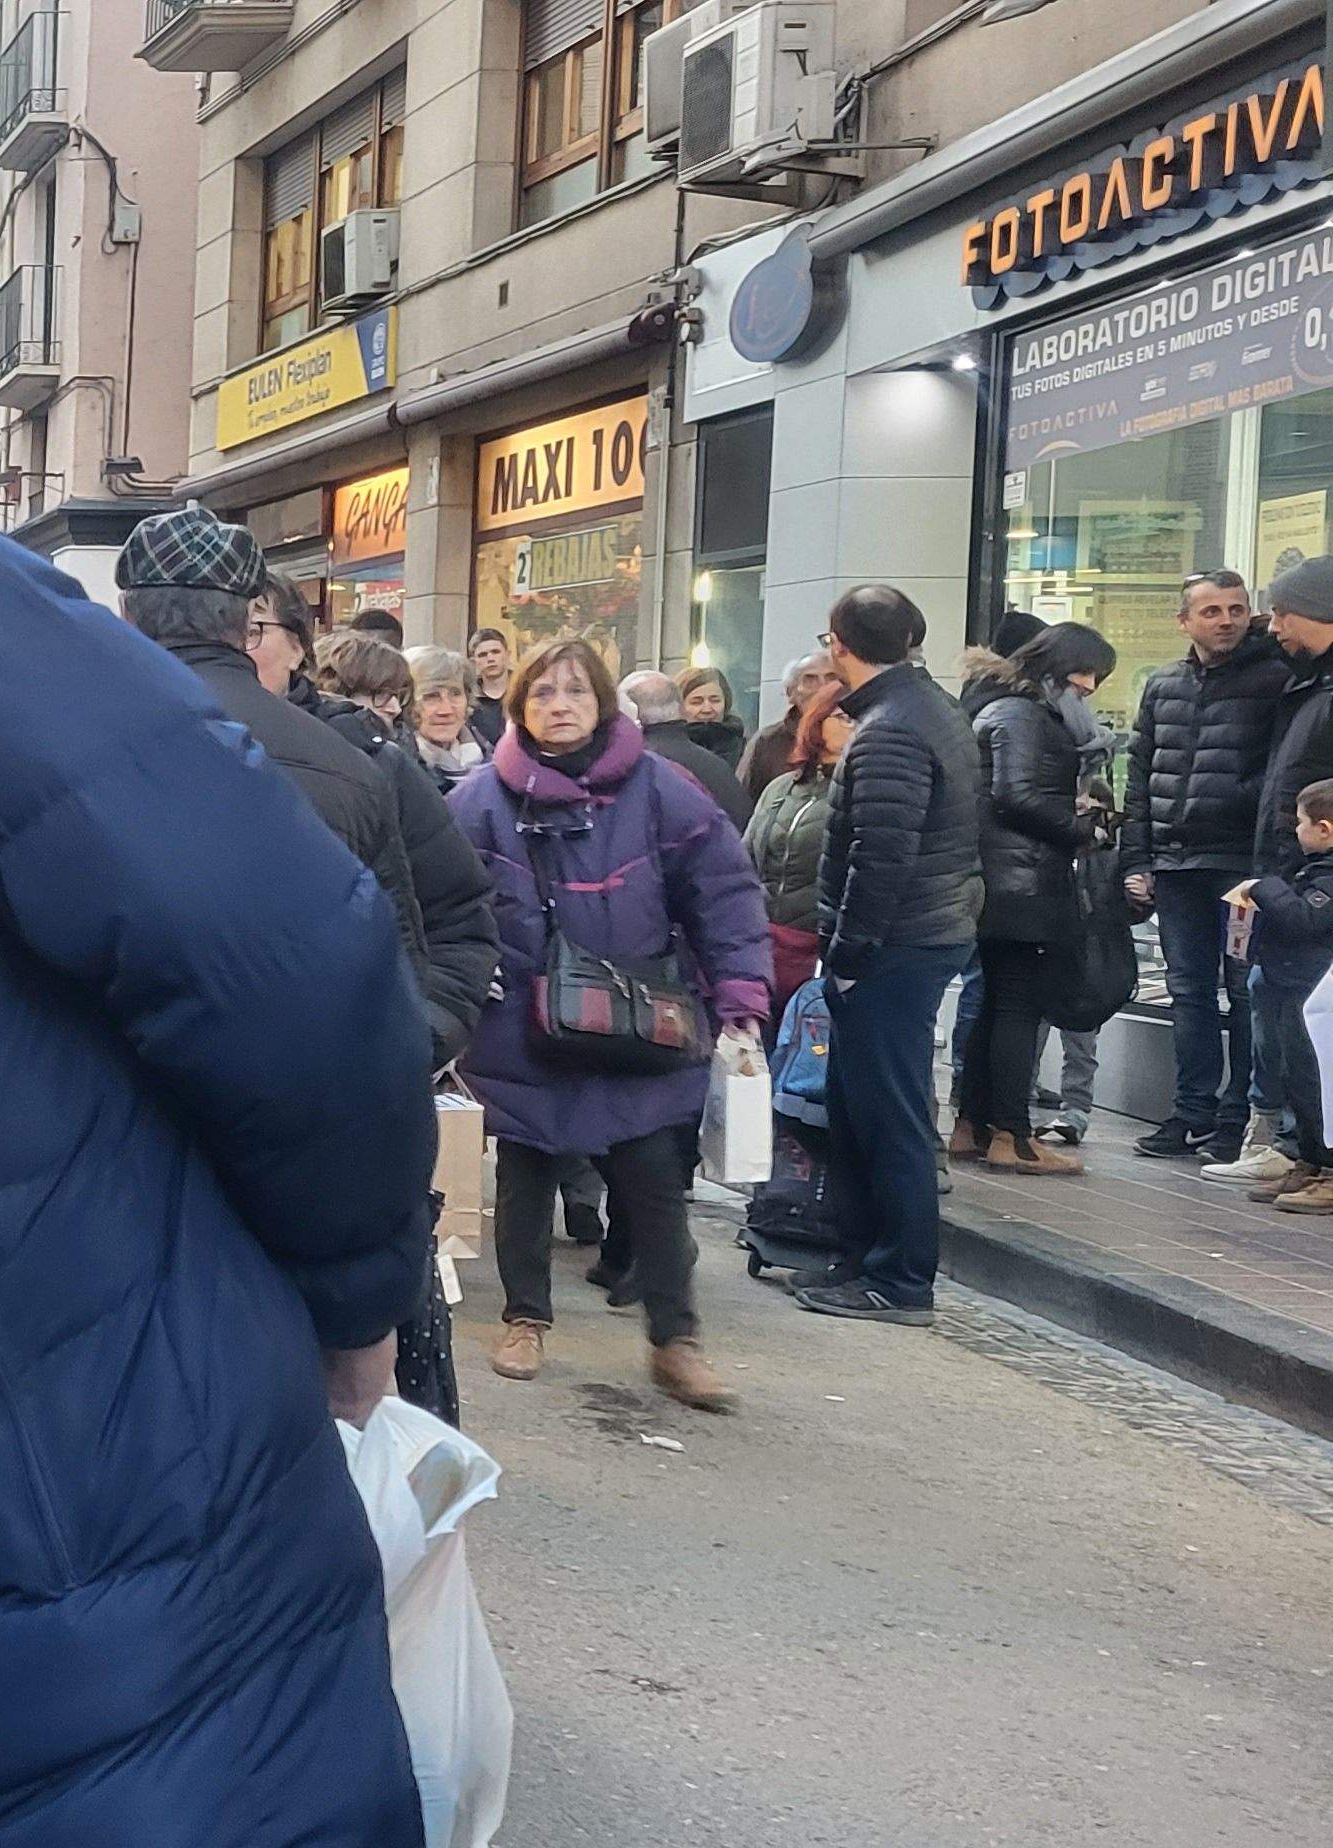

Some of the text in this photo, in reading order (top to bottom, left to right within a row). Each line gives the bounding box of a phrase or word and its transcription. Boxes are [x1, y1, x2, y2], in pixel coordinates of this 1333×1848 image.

[961, 64, 1325, 287] FOTOACTIVA
[1011, 236, 1333, 377] LABORATORIO DIGITAL
[1304, 304, 1333, 351] 0,
[1011, 295, 1301, 401] TUS FOTOS DIGITALES EN 5 MINUTOS Y DESDE
[247, 364, 283, 405] EULEN
[1008, 400, 1119, 442] FOTOACTIVA
[491, 436, 575, 516] MAXI
[533, 525, 618, 588] REBAJAS
